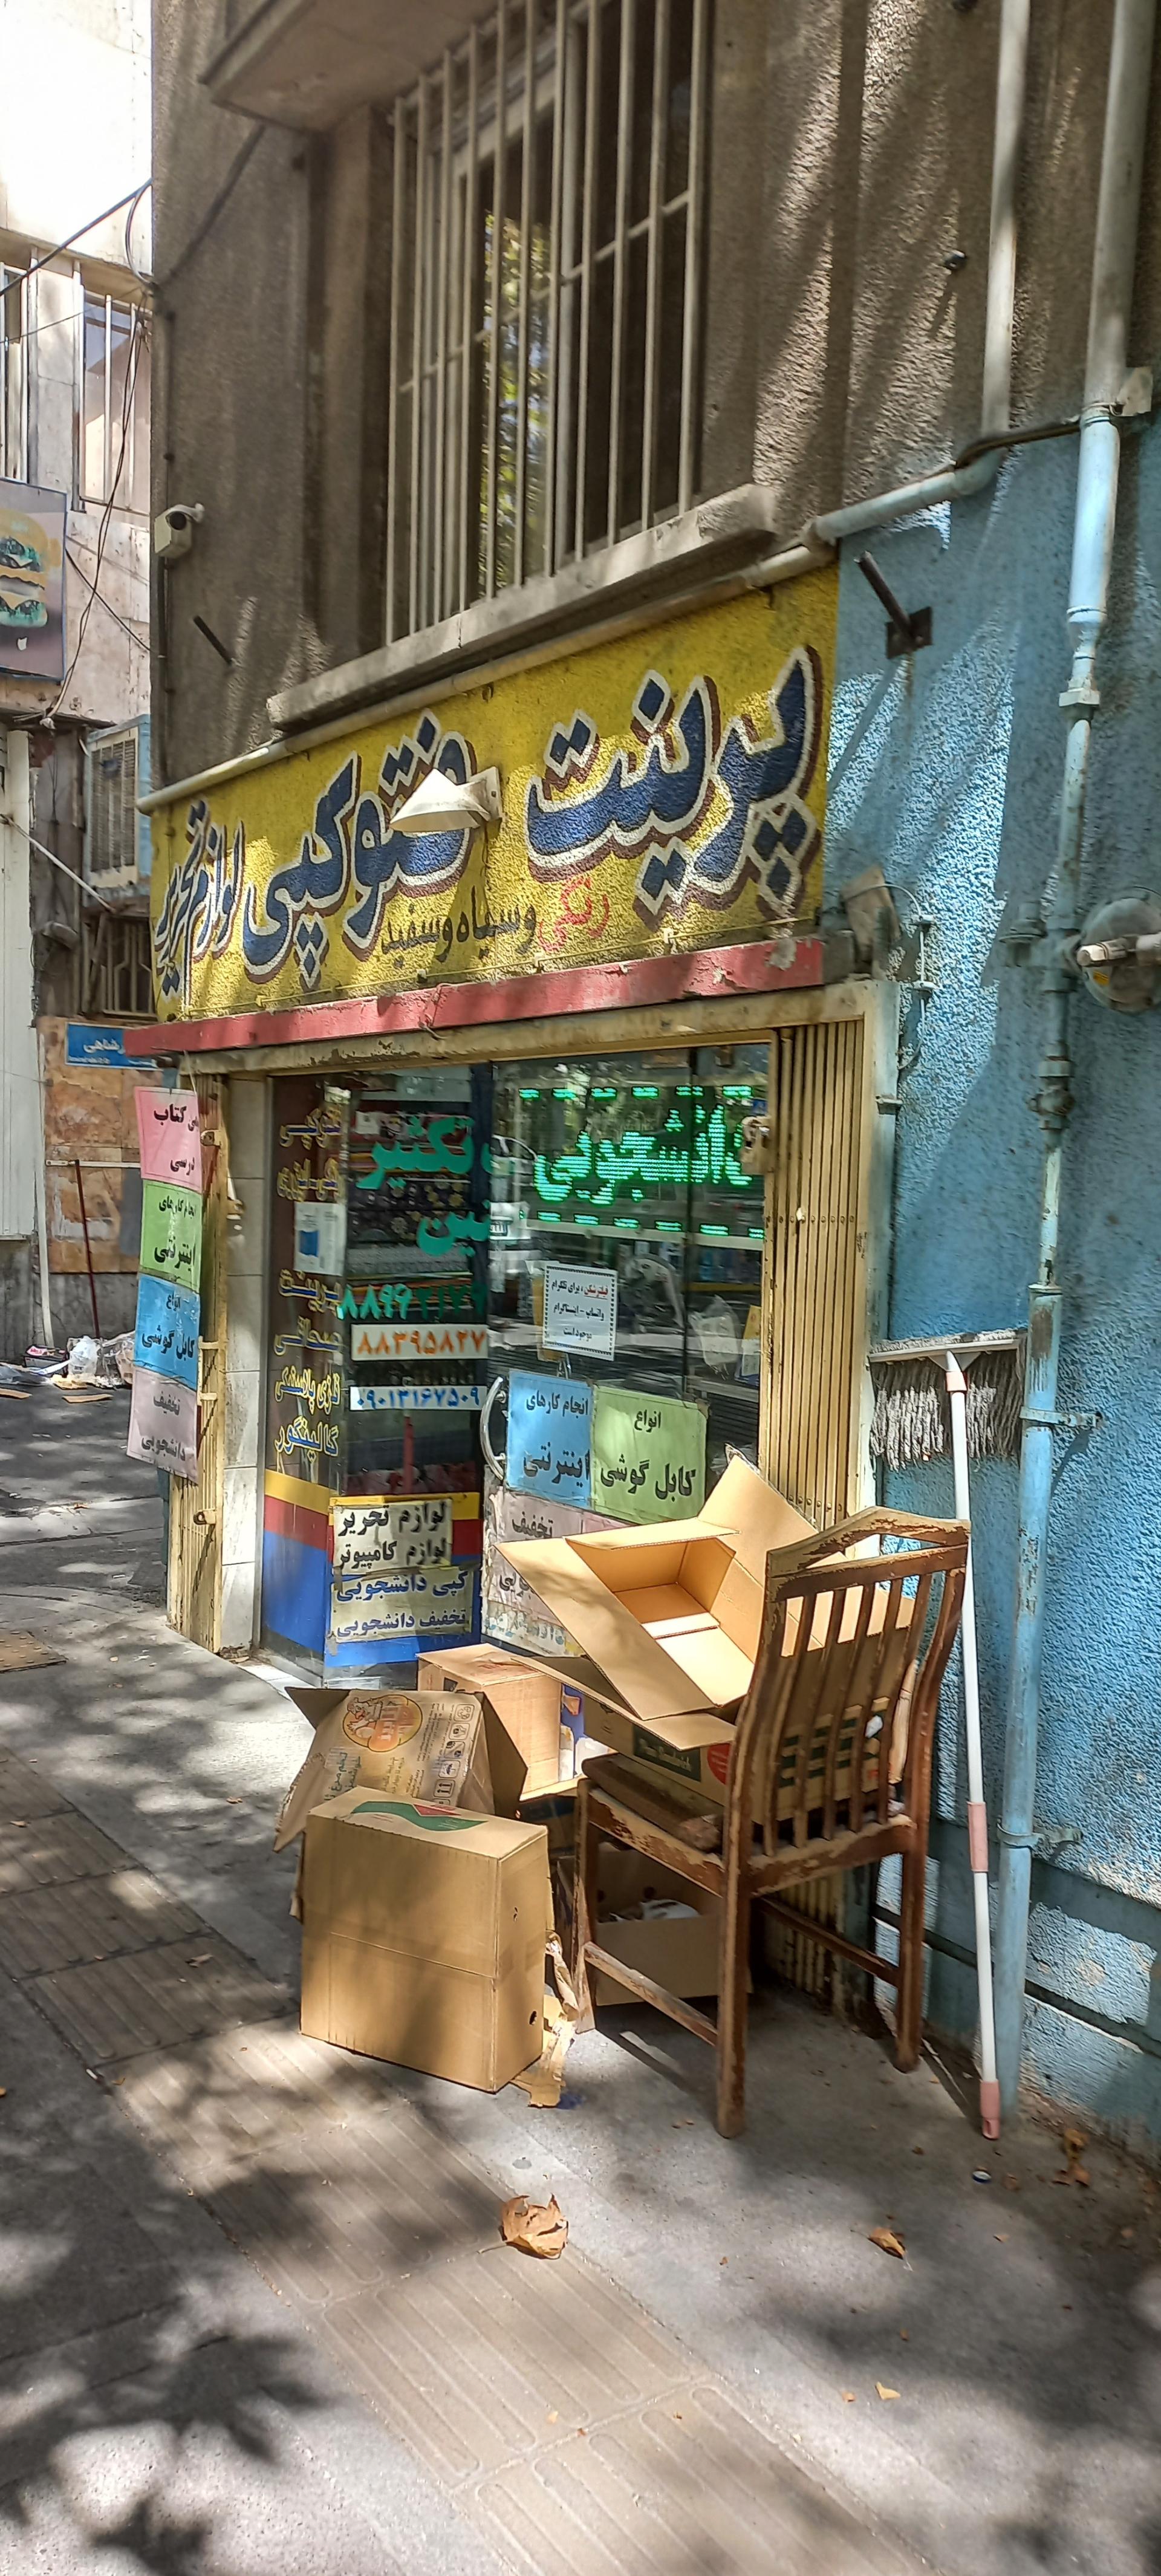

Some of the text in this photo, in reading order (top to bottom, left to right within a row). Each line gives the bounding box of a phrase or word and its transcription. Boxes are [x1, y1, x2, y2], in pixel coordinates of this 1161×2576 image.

[154, 646, 824, 1008] پرینت فتوکپی لوازم تحریر
[538, 877, 610, 953] رنگی
[153, 1103, 187, 1126] کتاب
[170, 1157, 195, 1176] درسی
[356, 1114, 475, 1190] تکثیر
[533, 1103, 754, 1205] دانشجویی
[158, 1195, 184, 1215] کارهای
[154, 1235, 196, 1272] اینترنتی
[166, 1291, 181, 1312] انواع
[567, 1282, 580, 1294] برای
[141, 1324, 195, 1362] کابل گوشی
[153, 1391, 181, 1416] تخفیف
[525, 1390, 588, 1420] انجام کارهای
[633, 1409, 662, 1433] انواع
[141, 1436, 186, 1462] دانشجویی
[274, 1414, 340, 1463] گالینگور
[522, 1442, 590, 1488] اینترنتی
[600, 1453, 697, 1503] کابل گوشی
[337, 1501, 446, 1537] لوازم تحریر
[511, 1511, 554, 1539] تخفیف
[336, 1538, 446, 1570] لوازم کامپیوتر
[336, 1572, 428, 1602] دانشجویی
[432, 1570, 468, 1596] کپی
[336, 1611, 415, 1638] دانشجویی
[419, 1609, 467, 1630] تخفیف
